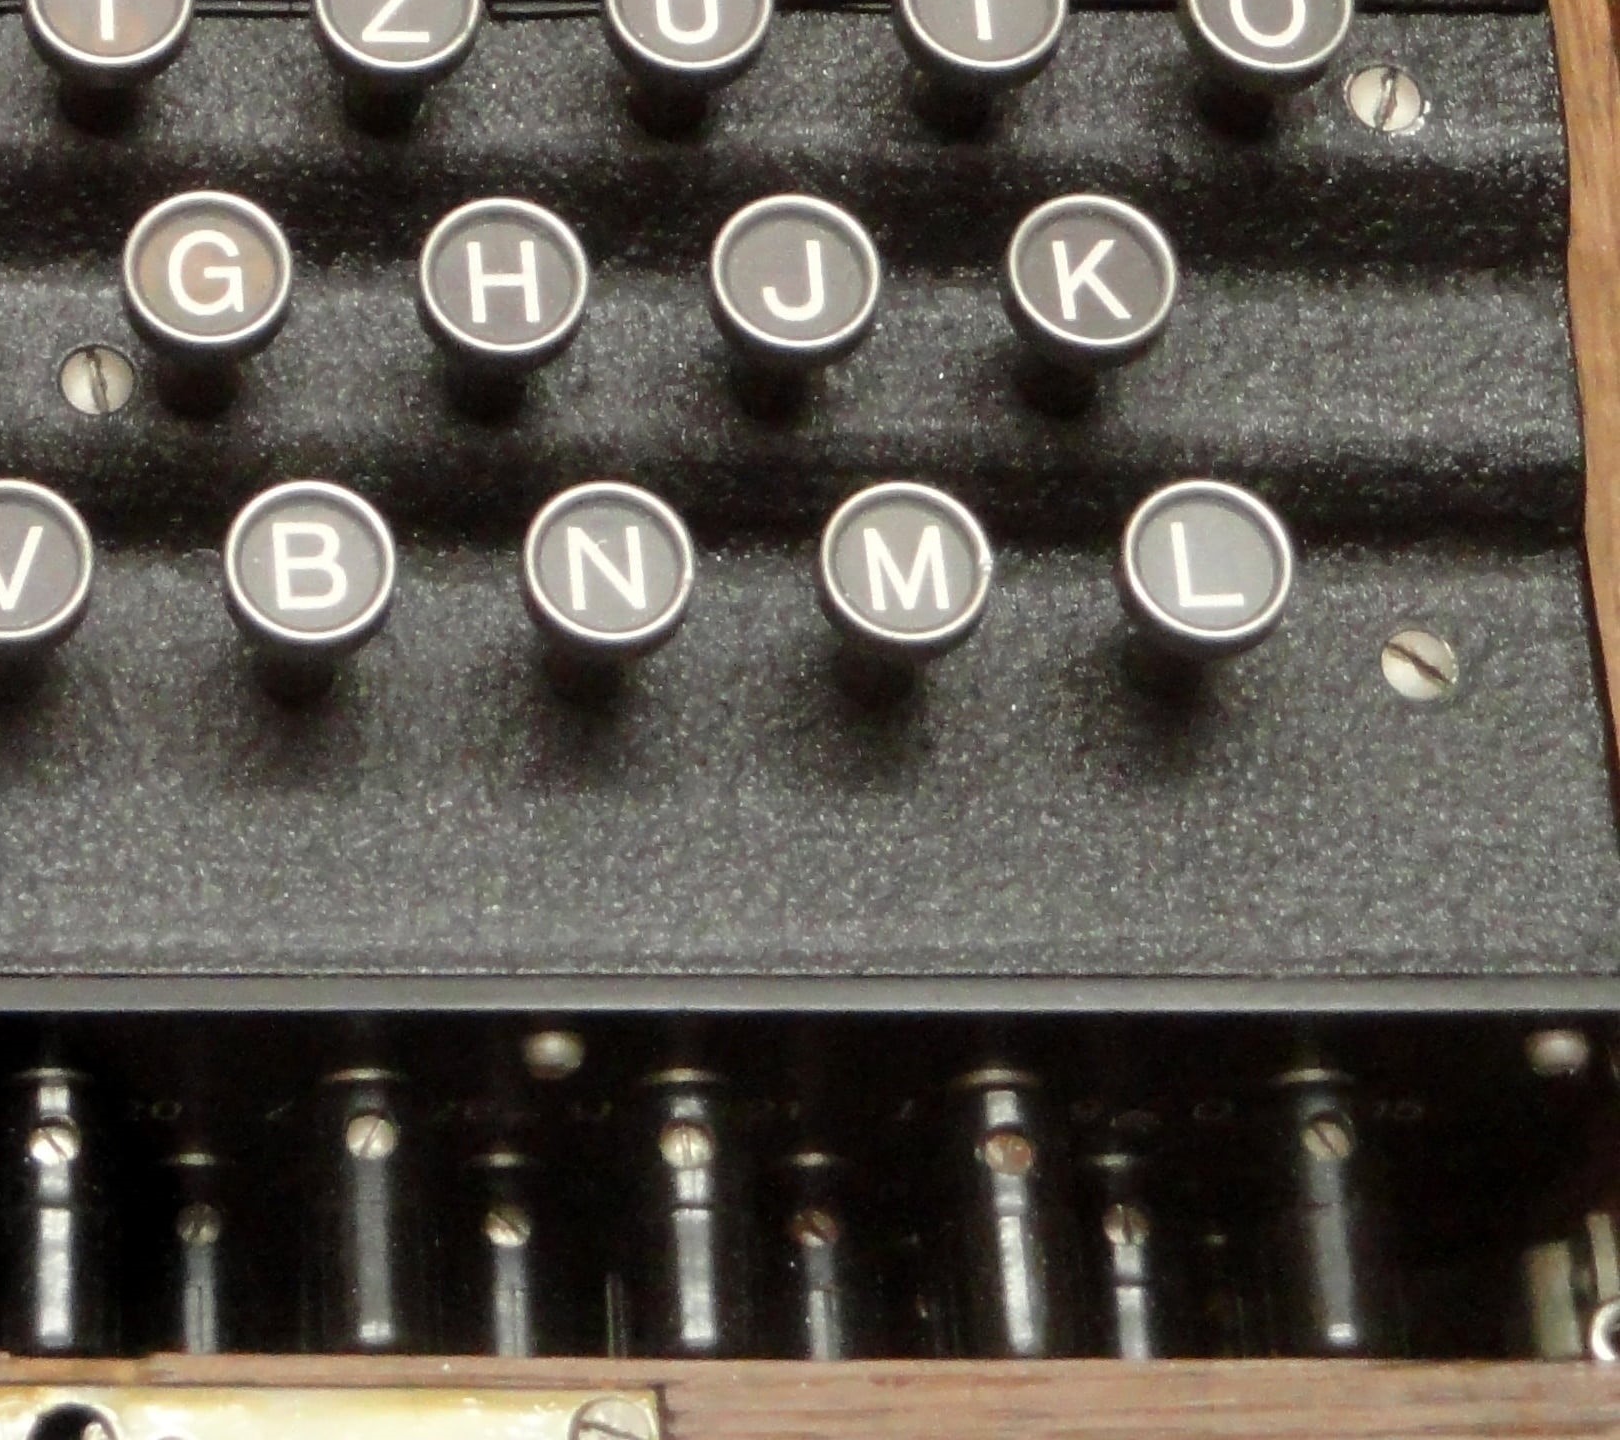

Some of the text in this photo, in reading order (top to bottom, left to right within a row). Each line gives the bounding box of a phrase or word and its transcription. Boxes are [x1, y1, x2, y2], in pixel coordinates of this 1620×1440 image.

[168, 230, 244, 316] G
[467, 241, 540, 323] H
[763, 240, 825, 321] J
[1053, 240, 1131, 319] K
[272, 522, 348, 611] B
[567, 526, 648, 611] N
[863, 526, 950, 612] M
[1170, 522, 1246, 610] L
